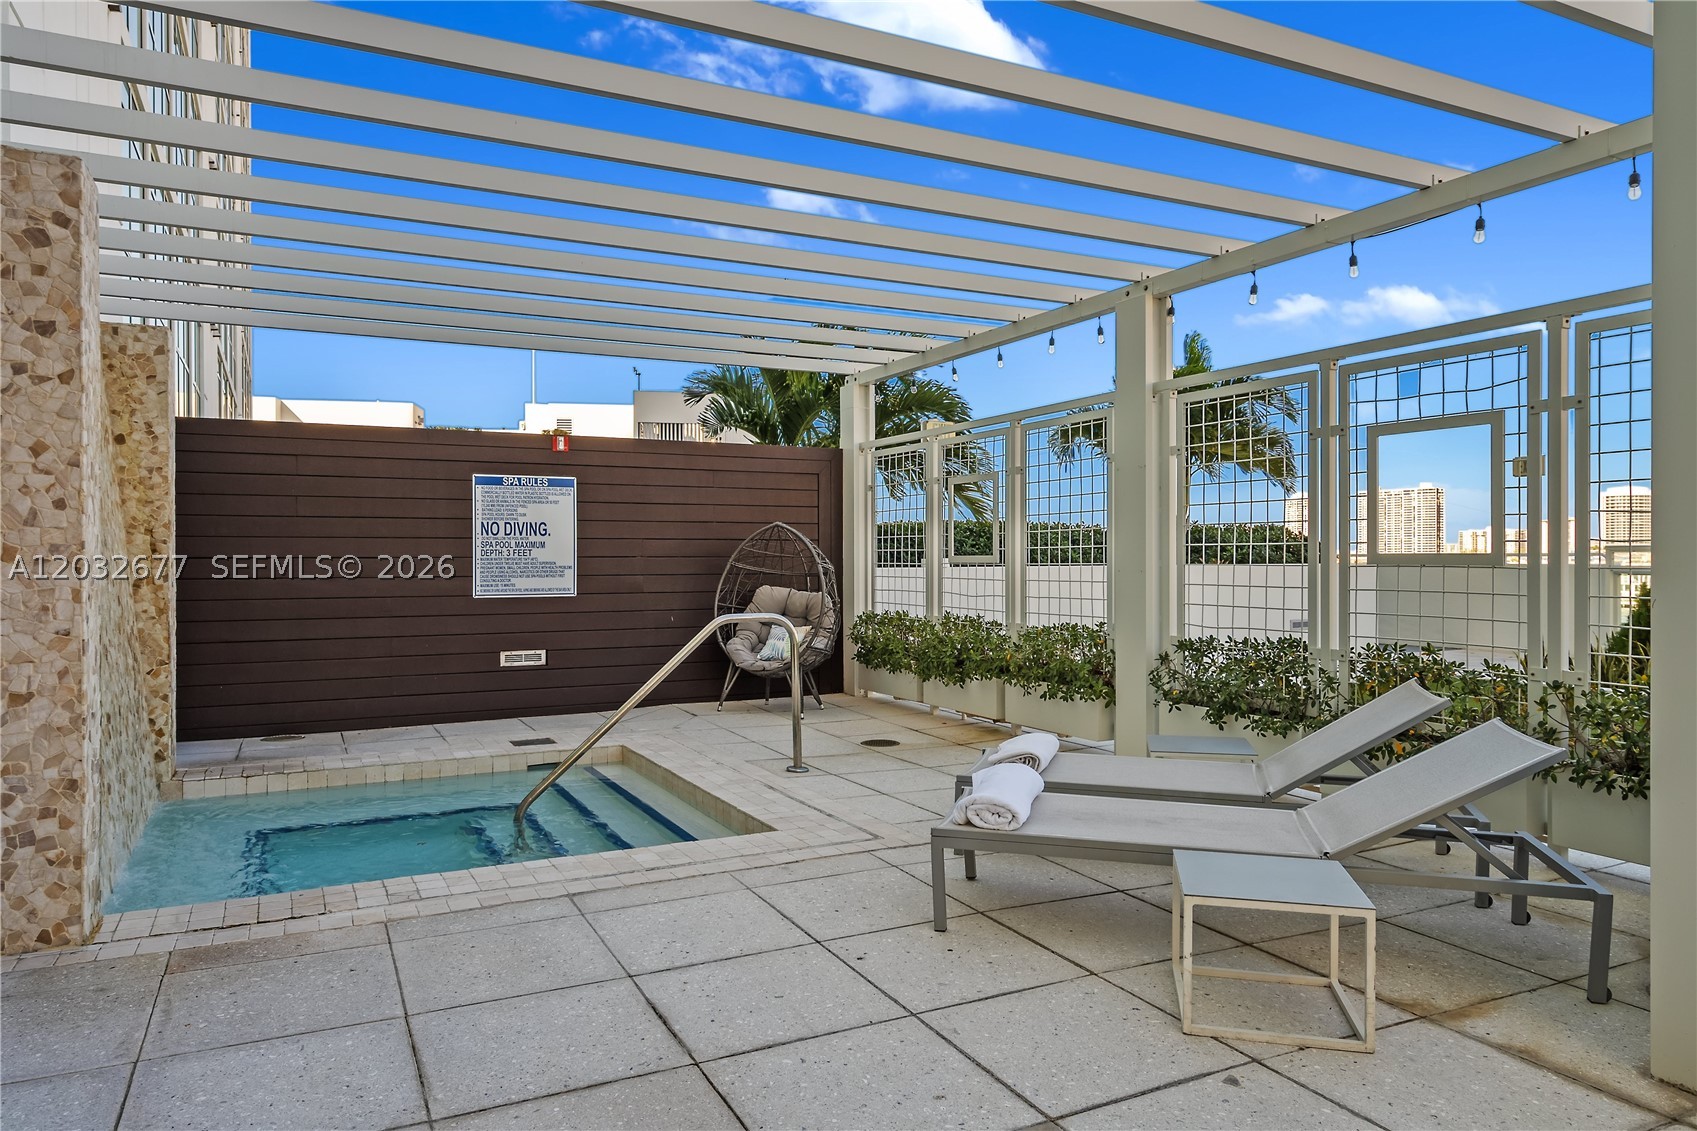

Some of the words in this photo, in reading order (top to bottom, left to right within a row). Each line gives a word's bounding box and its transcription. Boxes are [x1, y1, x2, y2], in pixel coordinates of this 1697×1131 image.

[502, 477, 520, 486] SPA
[521, 478, 548, 486] RULES
[481, 522, 500, 536] NO
[504, 522, 551, 536] DIVING.
